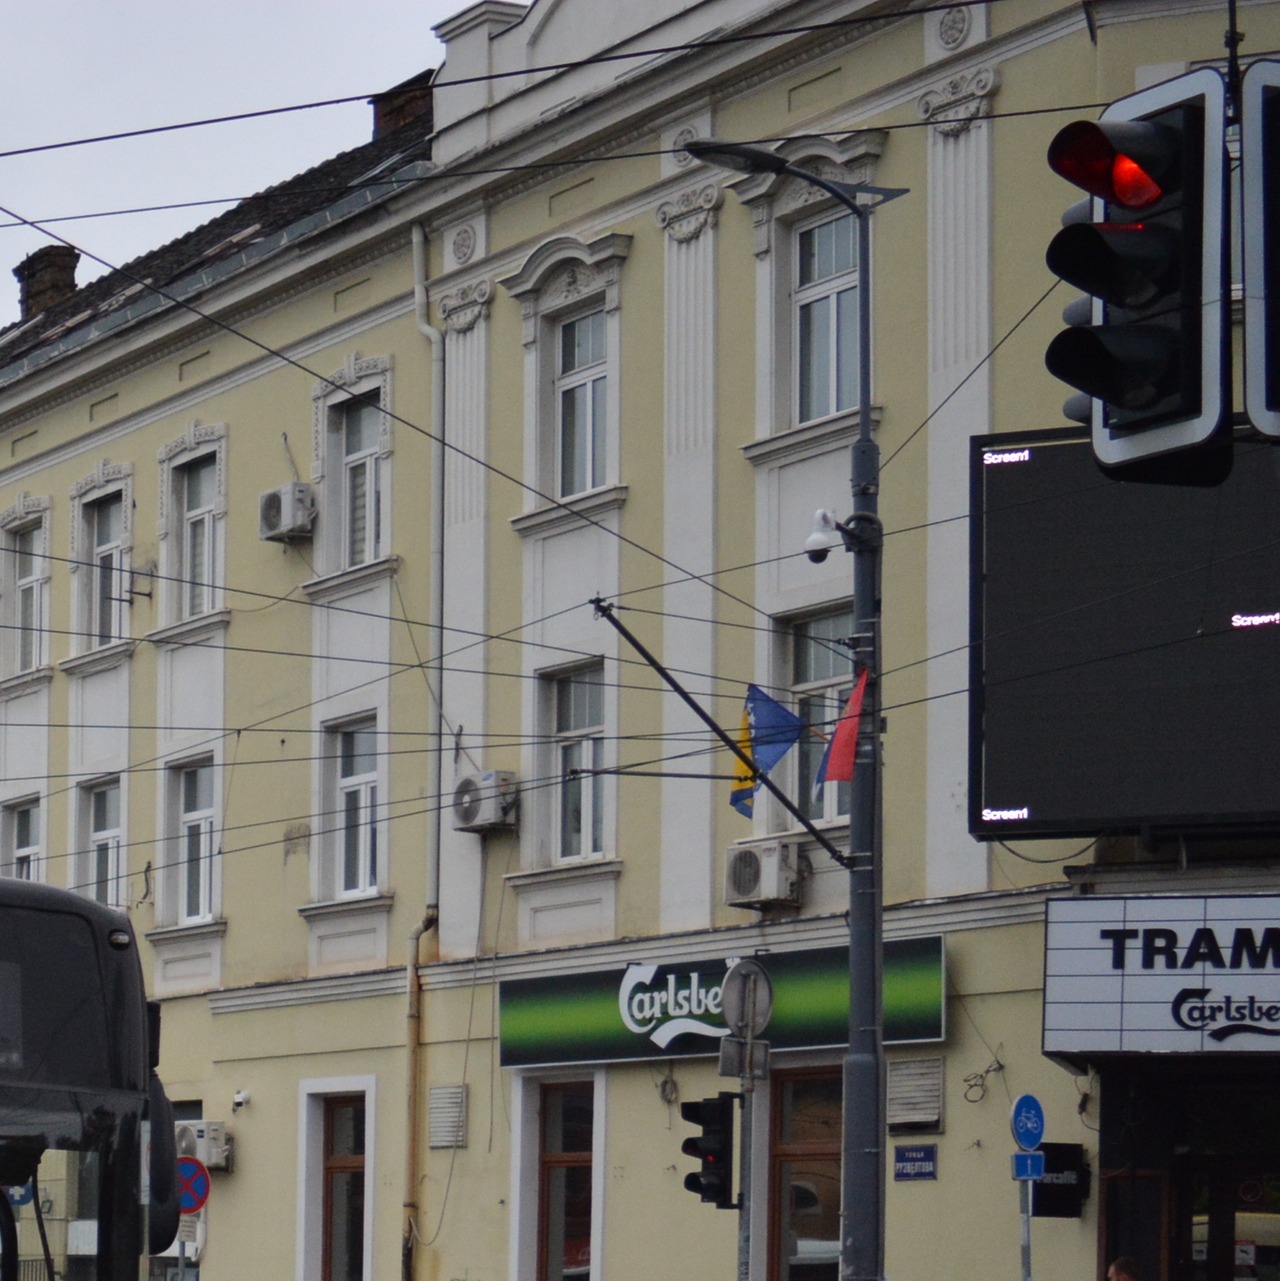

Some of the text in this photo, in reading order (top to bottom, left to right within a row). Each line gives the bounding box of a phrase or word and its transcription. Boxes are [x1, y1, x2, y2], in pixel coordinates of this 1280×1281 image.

[983, 450, 1029, 464] Screen1
[982, 808, 1028, 821] Screen1
[1099, 928, 1280, 970] TRAM
[619, 965, 724, 1034] Carlsbe
